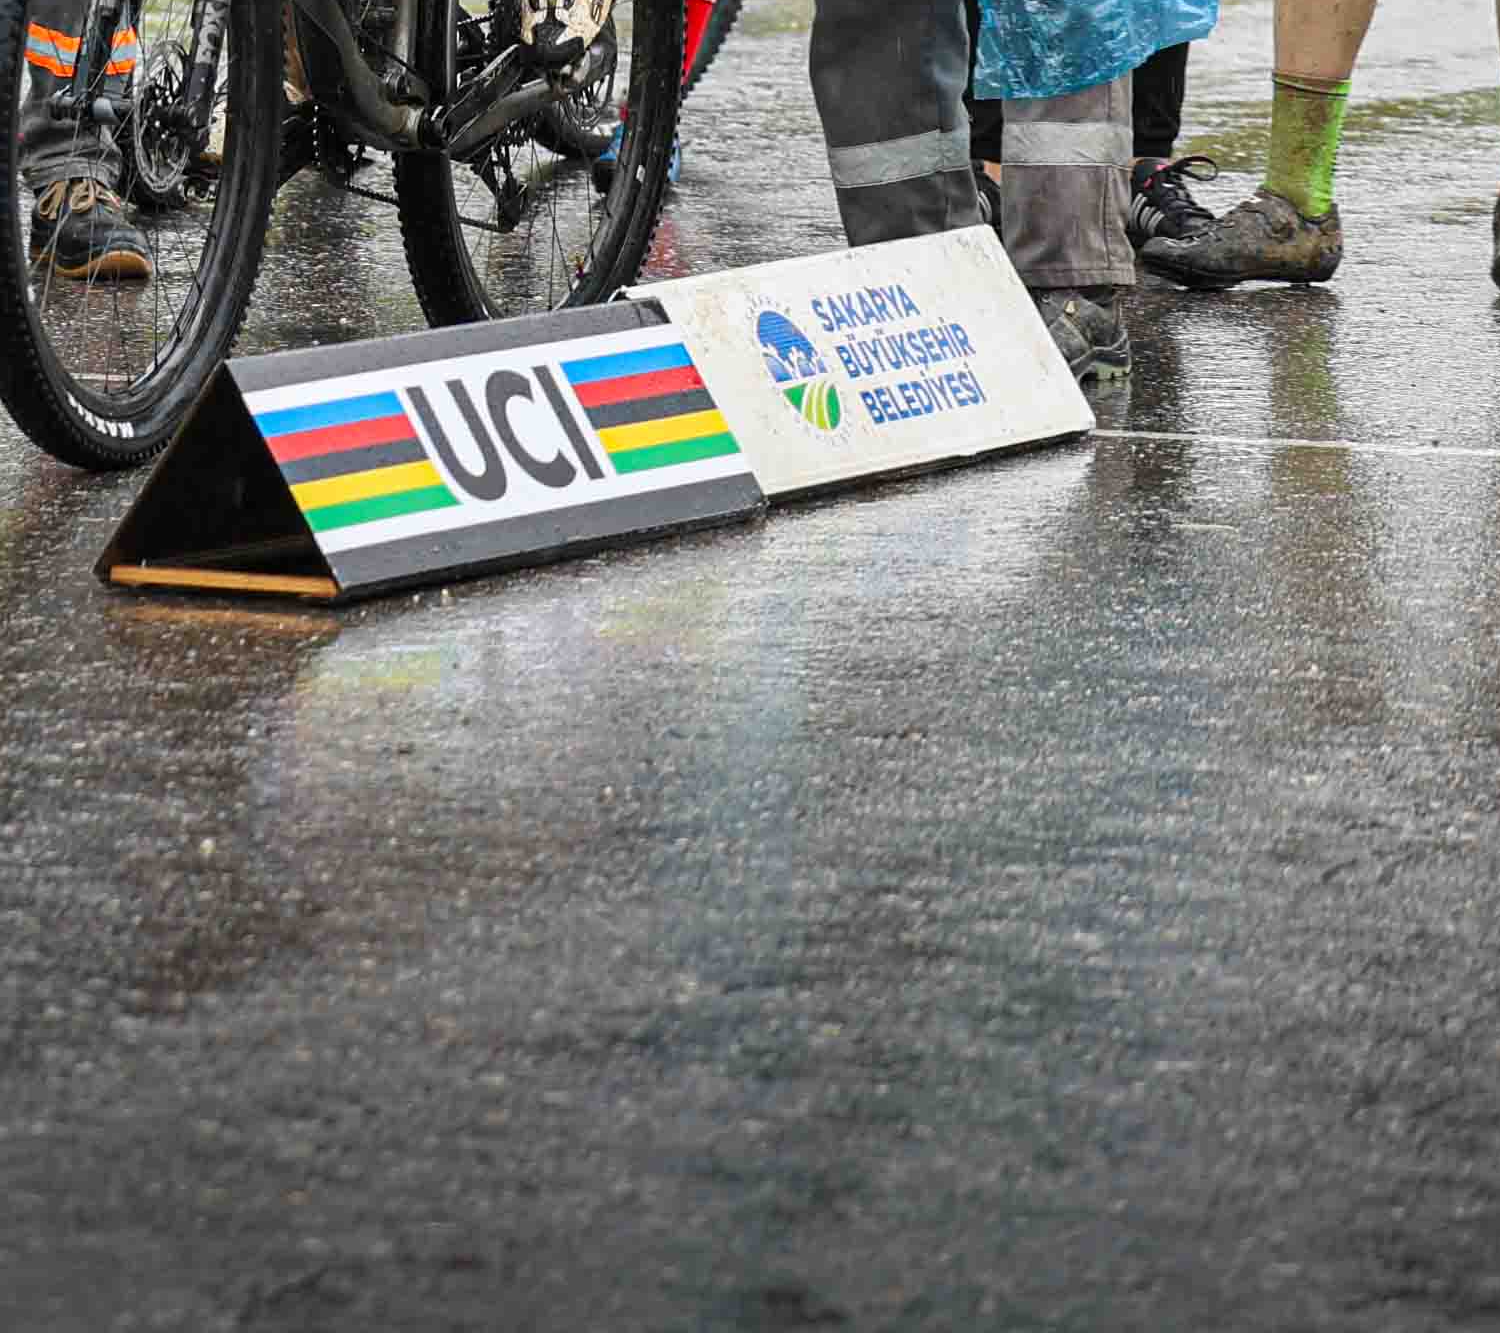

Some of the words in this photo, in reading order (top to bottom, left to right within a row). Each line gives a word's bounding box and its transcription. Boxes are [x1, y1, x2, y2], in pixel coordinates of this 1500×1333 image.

[810, 284, 920, 333] SAKARYA
[835, 316, 977, 378] BÜYÜKŞEHİR
[859, 361, 988, 425] BELEDİYESİ
[406, 363, 605, 502] UCI
